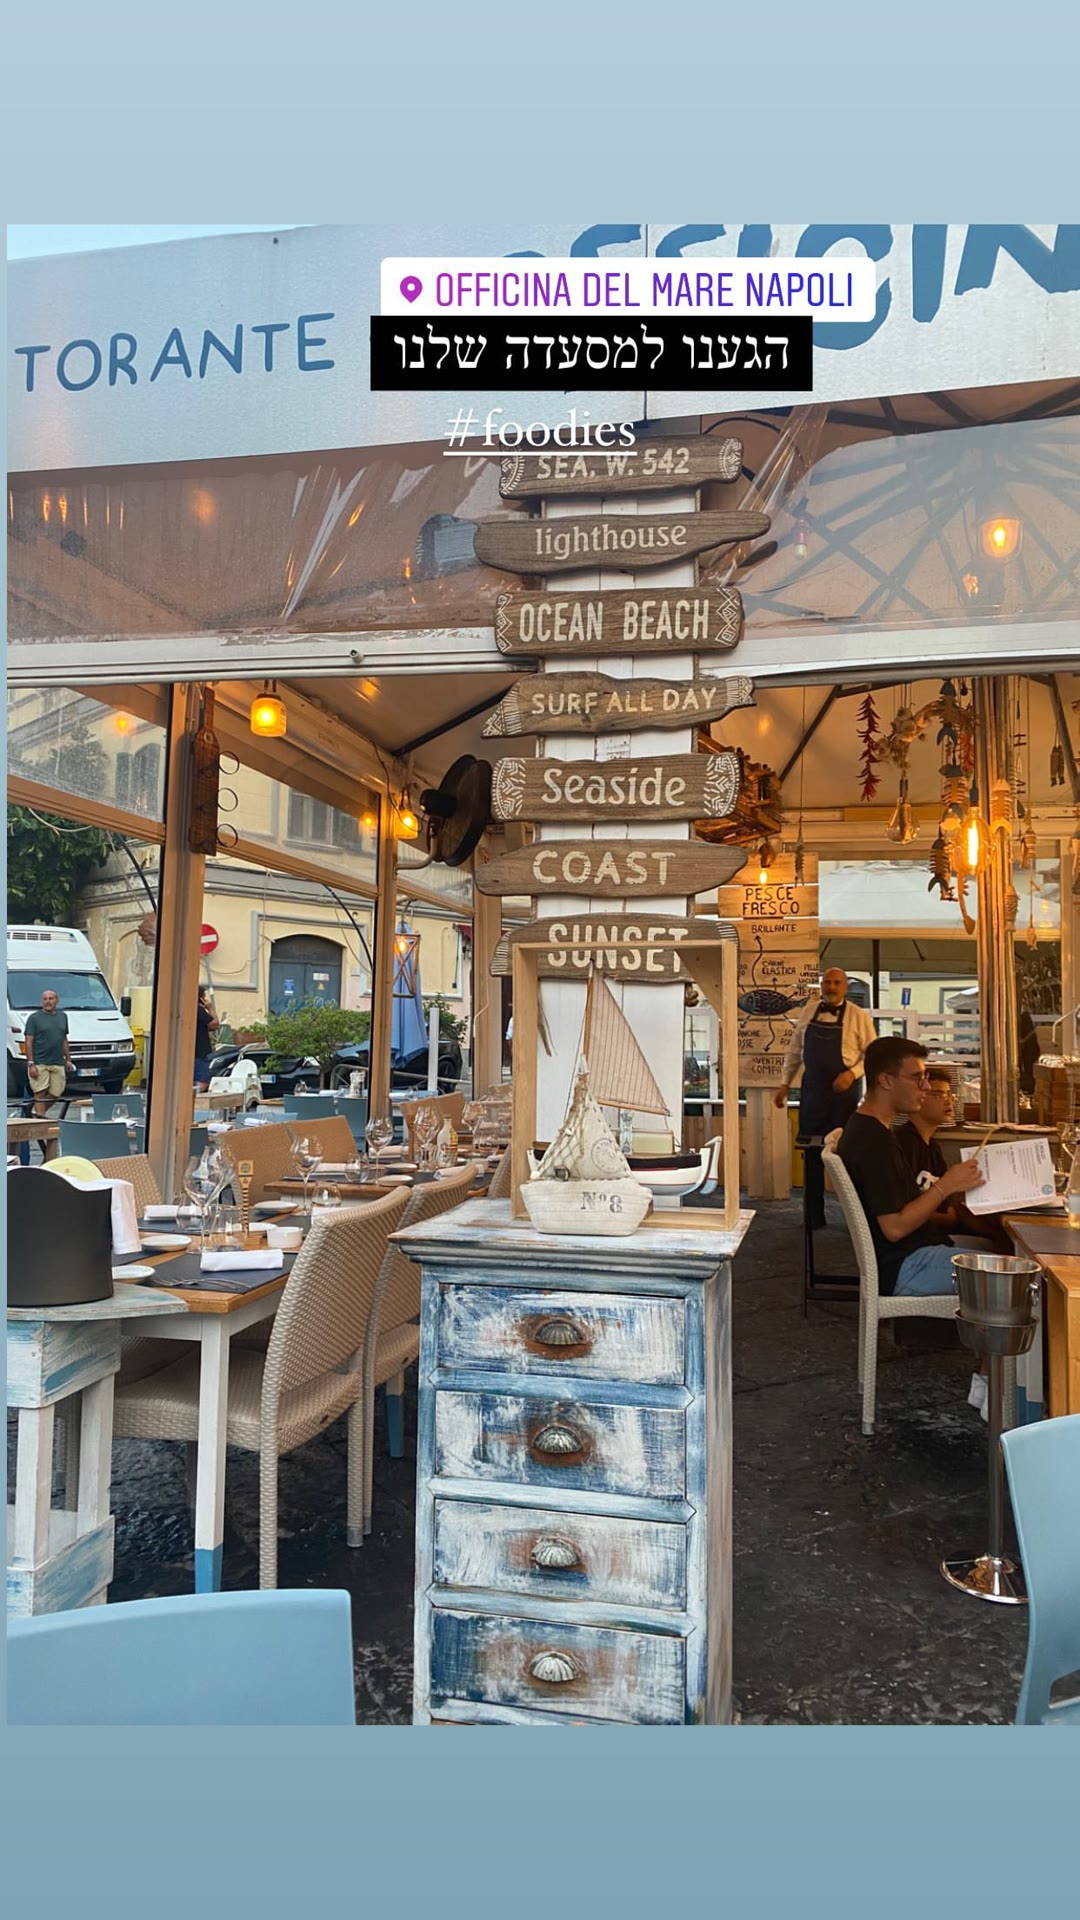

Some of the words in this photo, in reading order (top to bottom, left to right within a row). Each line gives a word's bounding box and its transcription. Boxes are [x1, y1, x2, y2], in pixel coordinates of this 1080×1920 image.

[14, 312, 335, 393] TORANTE
[536, 452, 596, 480] SEA.
[606, 450, 634, 477] W.
[641, 447, 690, 476] 542
[535, 523, 688, 560] lighthouse
[518, 601, 604, 643] OCEAN
[622, 599, 710, 641] BEACH
[531, 691, 599, 716] SURF
[605, 689, 655, 713] ALL
[662, 686, 717, 711] DAY
[541, 767, 687, 807] Seaside
[532, 850, 677, 886] COAST
[742, 901, 800, 916] FRESCO
[745, 886, 794, 901] PESCE
[751, 923, 797, 934] BRILLANTE
[547, 922, 689, 973] SUNSET
[761, 967, 797, 976] ELASTICA
[752, 1065, 782, 1075] COMPA
